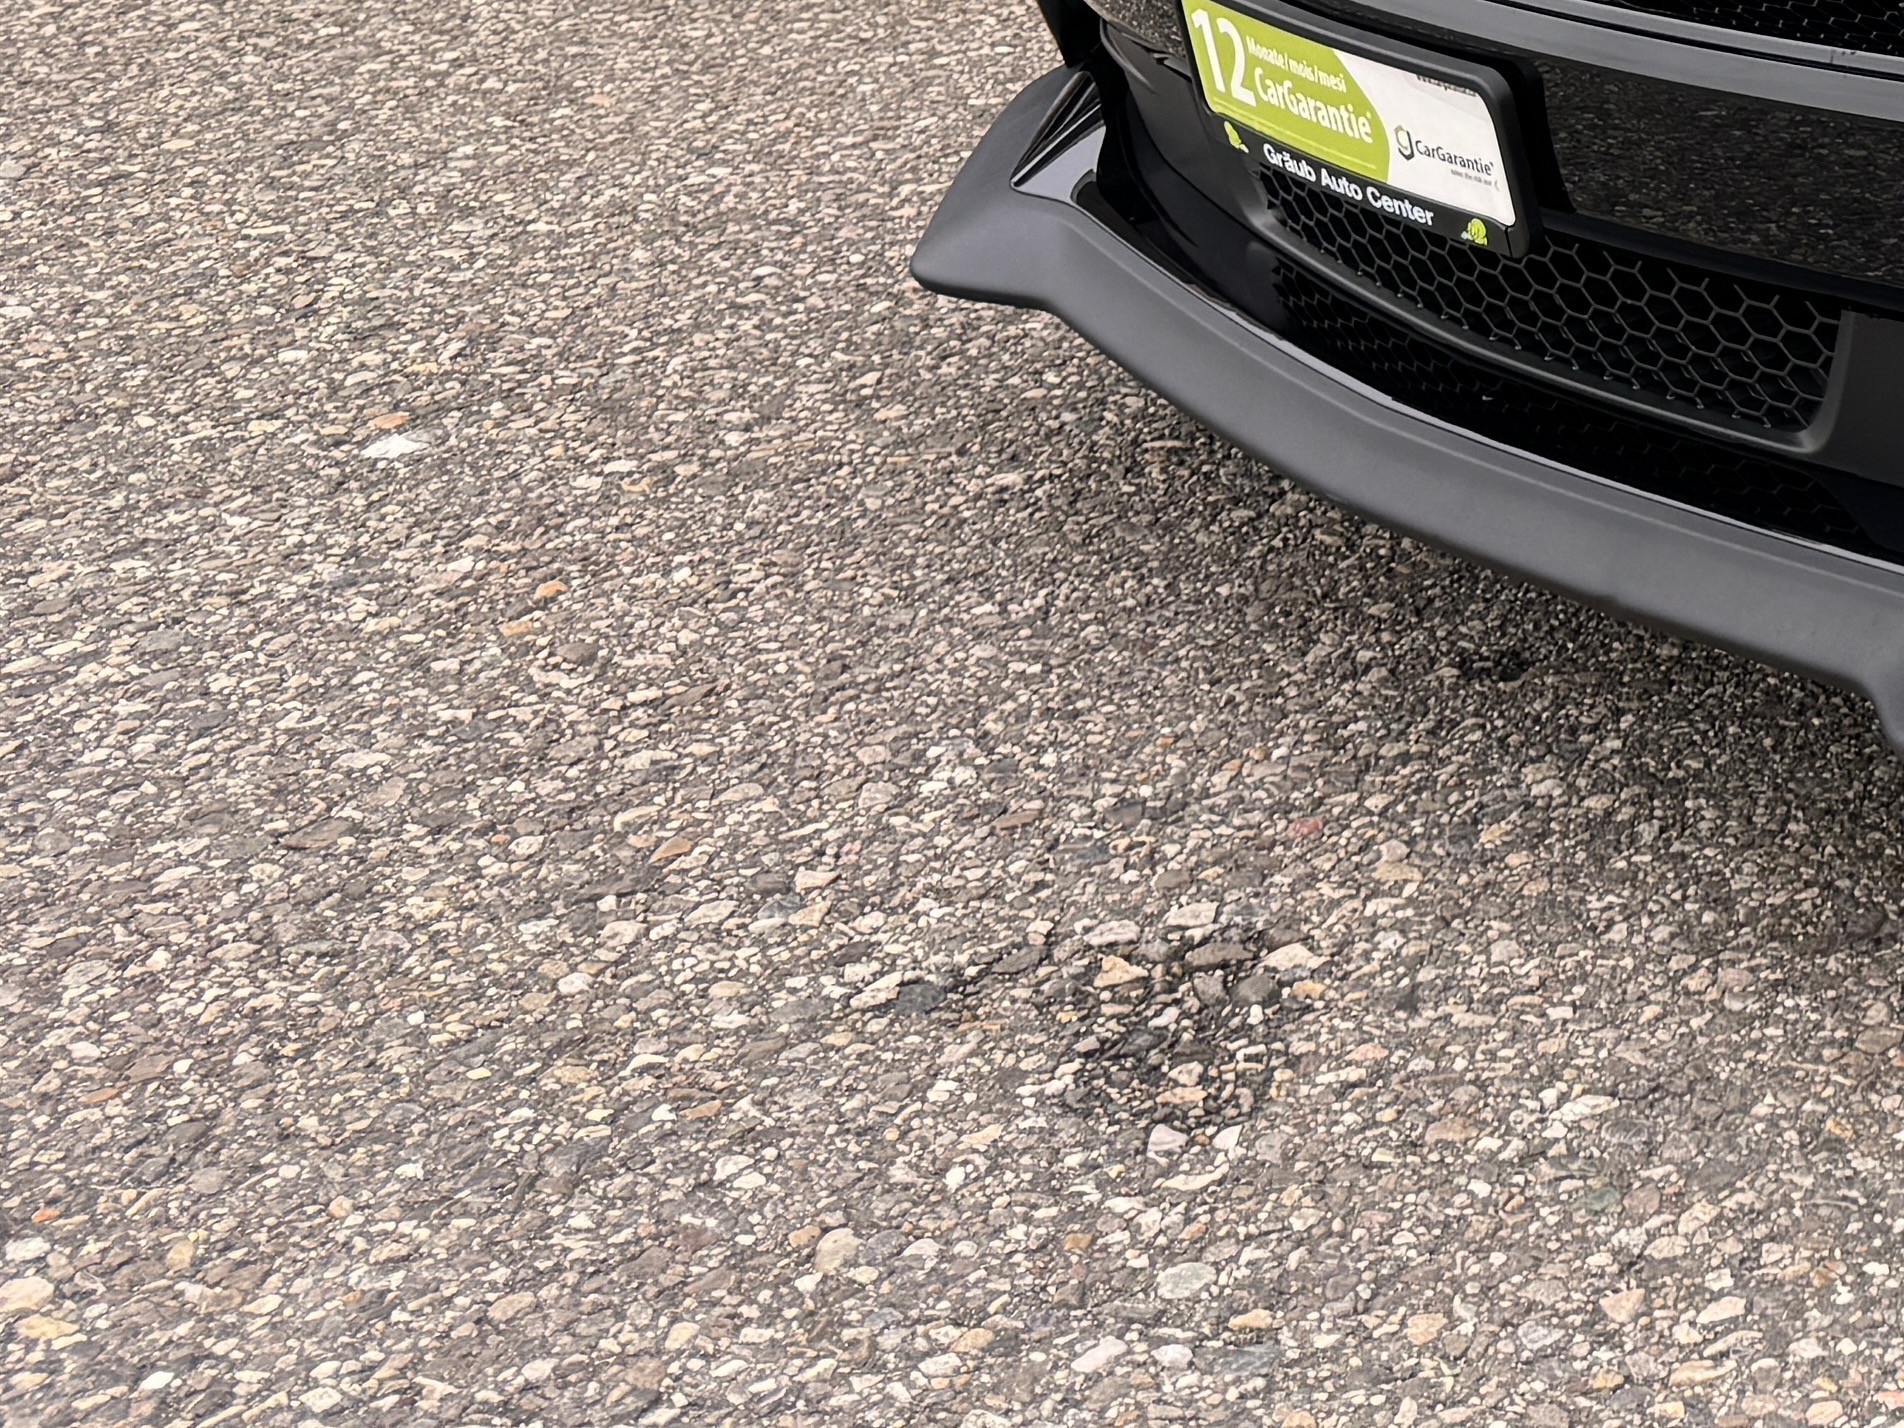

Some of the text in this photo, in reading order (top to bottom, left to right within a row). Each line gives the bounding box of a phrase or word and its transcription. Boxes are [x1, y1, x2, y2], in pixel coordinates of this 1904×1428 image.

[1191, 8, 1257, 107] 12
[1254, 66, 1373, 144] CarGarantie
[1263, 143, 1435, 226] Gräub Auto Center
[1415, 140, 1494, 176] CarGarantie
